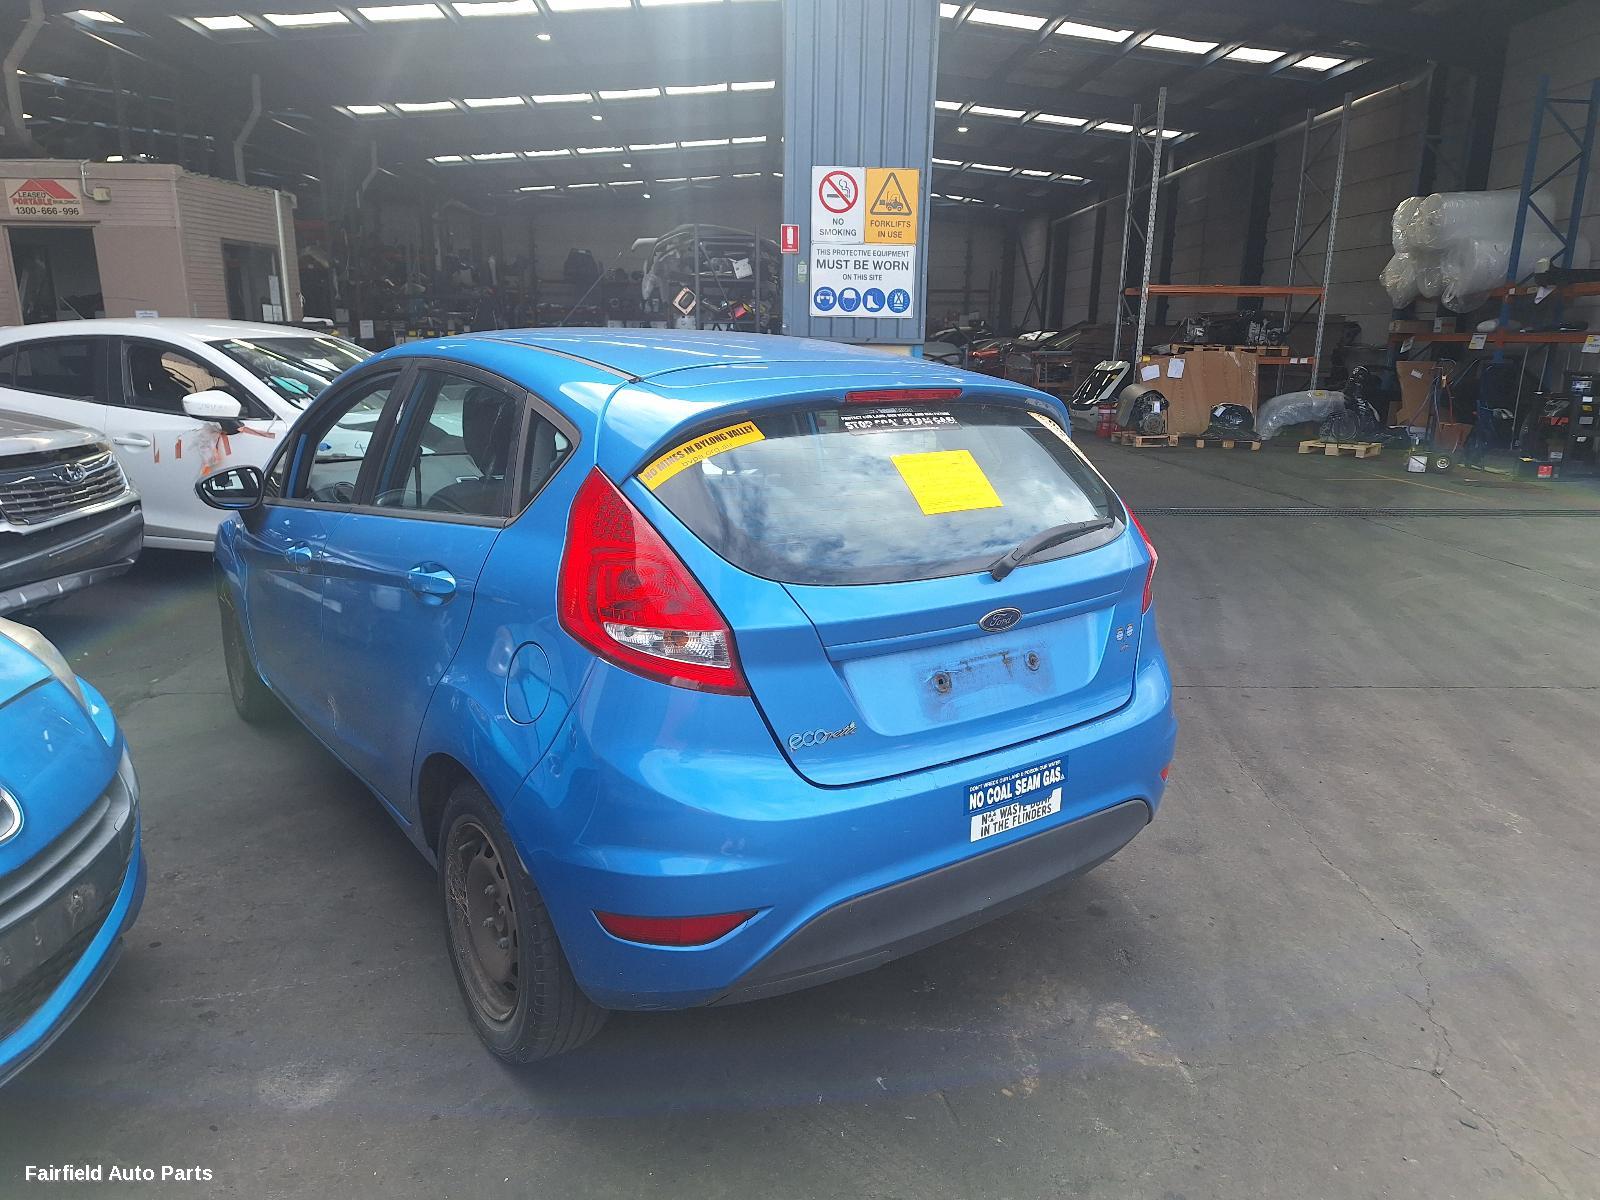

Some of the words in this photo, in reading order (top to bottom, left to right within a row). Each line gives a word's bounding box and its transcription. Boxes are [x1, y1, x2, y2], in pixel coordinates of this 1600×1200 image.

[15, 206, 80, 216] 1300-666-996
[832, 217, 845, 226] NO
[870, 219, 912, 229] FORKLIFTS
[819, 228, 857, 237] SMOKING
[877, 230, 886, 238] IN
[887, 230, 903, 239] USE
[816, 248, 831, 256] THIS
[832, 248, 872, 257] PROTECTIVE
[872, 249, 910, 258] EQUIPMENT
[816, 258, 851, 270] MUST
[853, 259, 870, 271] BE
[872, 260, 909, 271] WORN
[842, 273, 852, 281] ON
[853, 273, 868, 281] THIS
[869, 273, 883, 281] SITE
[643, 466, 658, 482] NO
[656, 450, 686, 470] MINES
[683, 445, 696, 456] IN
[694, 433, 729, 451] BYLONG
[725, 424, 755, 439] VALLEY
[969, 790, 985, 811] NO
[986, 782, 1013, 805] COAL
[1014, 772, 1041, 796] SEAM
[980, 825, 990, 838] IN
[993, 818, 1010, 833] THE
[1012, 803, 1052, 827] FLINDERS
